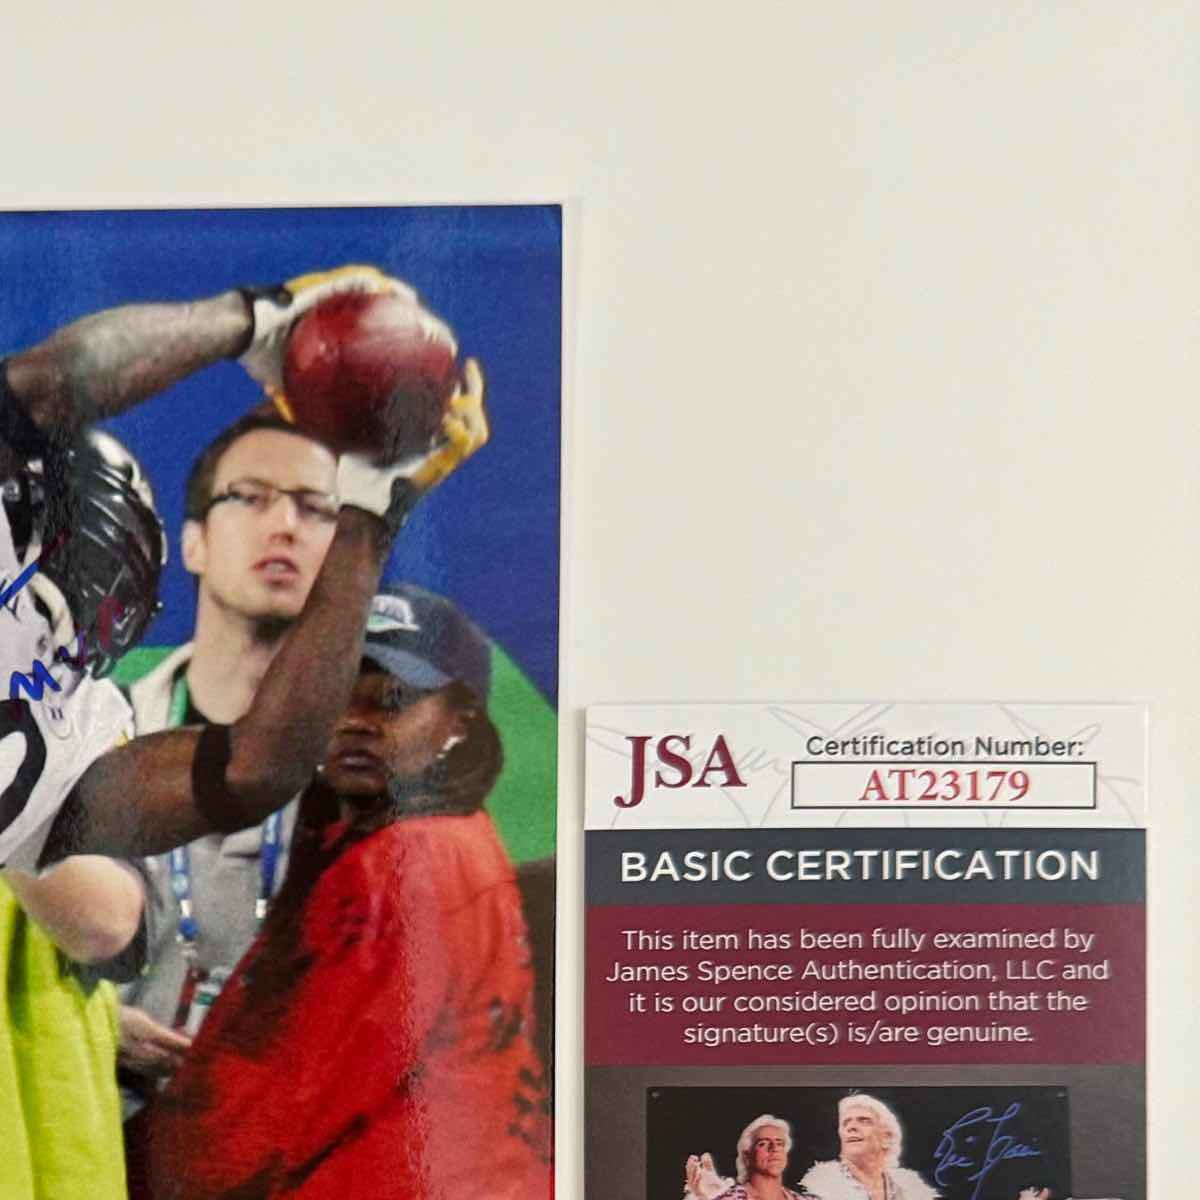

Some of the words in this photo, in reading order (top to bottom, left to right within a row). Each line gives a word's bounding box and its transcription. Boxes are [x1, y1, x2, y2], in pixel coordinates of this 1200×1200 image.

[805, 734, 965, 757] Certification
[975, 735, 1085, 757] Number:
[613, 734, 748, 809] JSA
[858, 768, 1031, 803] AT23179
[621, 850, 752, 882] BASIC
[766, 849, 1100, 881] CERTIFICATION
[621, 929, 673, 951] This
[683, 929, 739, 950] item
[748, 928, 792, 950] has
[800, 928, 863, 949] been
[871, 927, 926, 953] fully
[933, 928, 1056, 949] examined
[1064, 928, 1095, 953] by
[605, 961, 689, 982] James
[697, 960, 793, 985] Spence
[801, 959, 998, 982] Authentication,
[1006, 959, 1055, 980] LLC
[1062, 959, 1109, 980] and
[629, 992, 646, 1013] it
[655, 992, 674, 1013] is
[682, 996, 727, 1013] our
[733, 990, 876, 1012] considered
[884, 991, 980, 1015] opinion
[988, 990, 1040, 1011] that
[1046, 990, 1089, 1011] the
[683, 1022, 839, 1047] signature(s)
[848, 1020, 921, 1045] is/are
[926, 1021, 1034, 1046] genuine.
